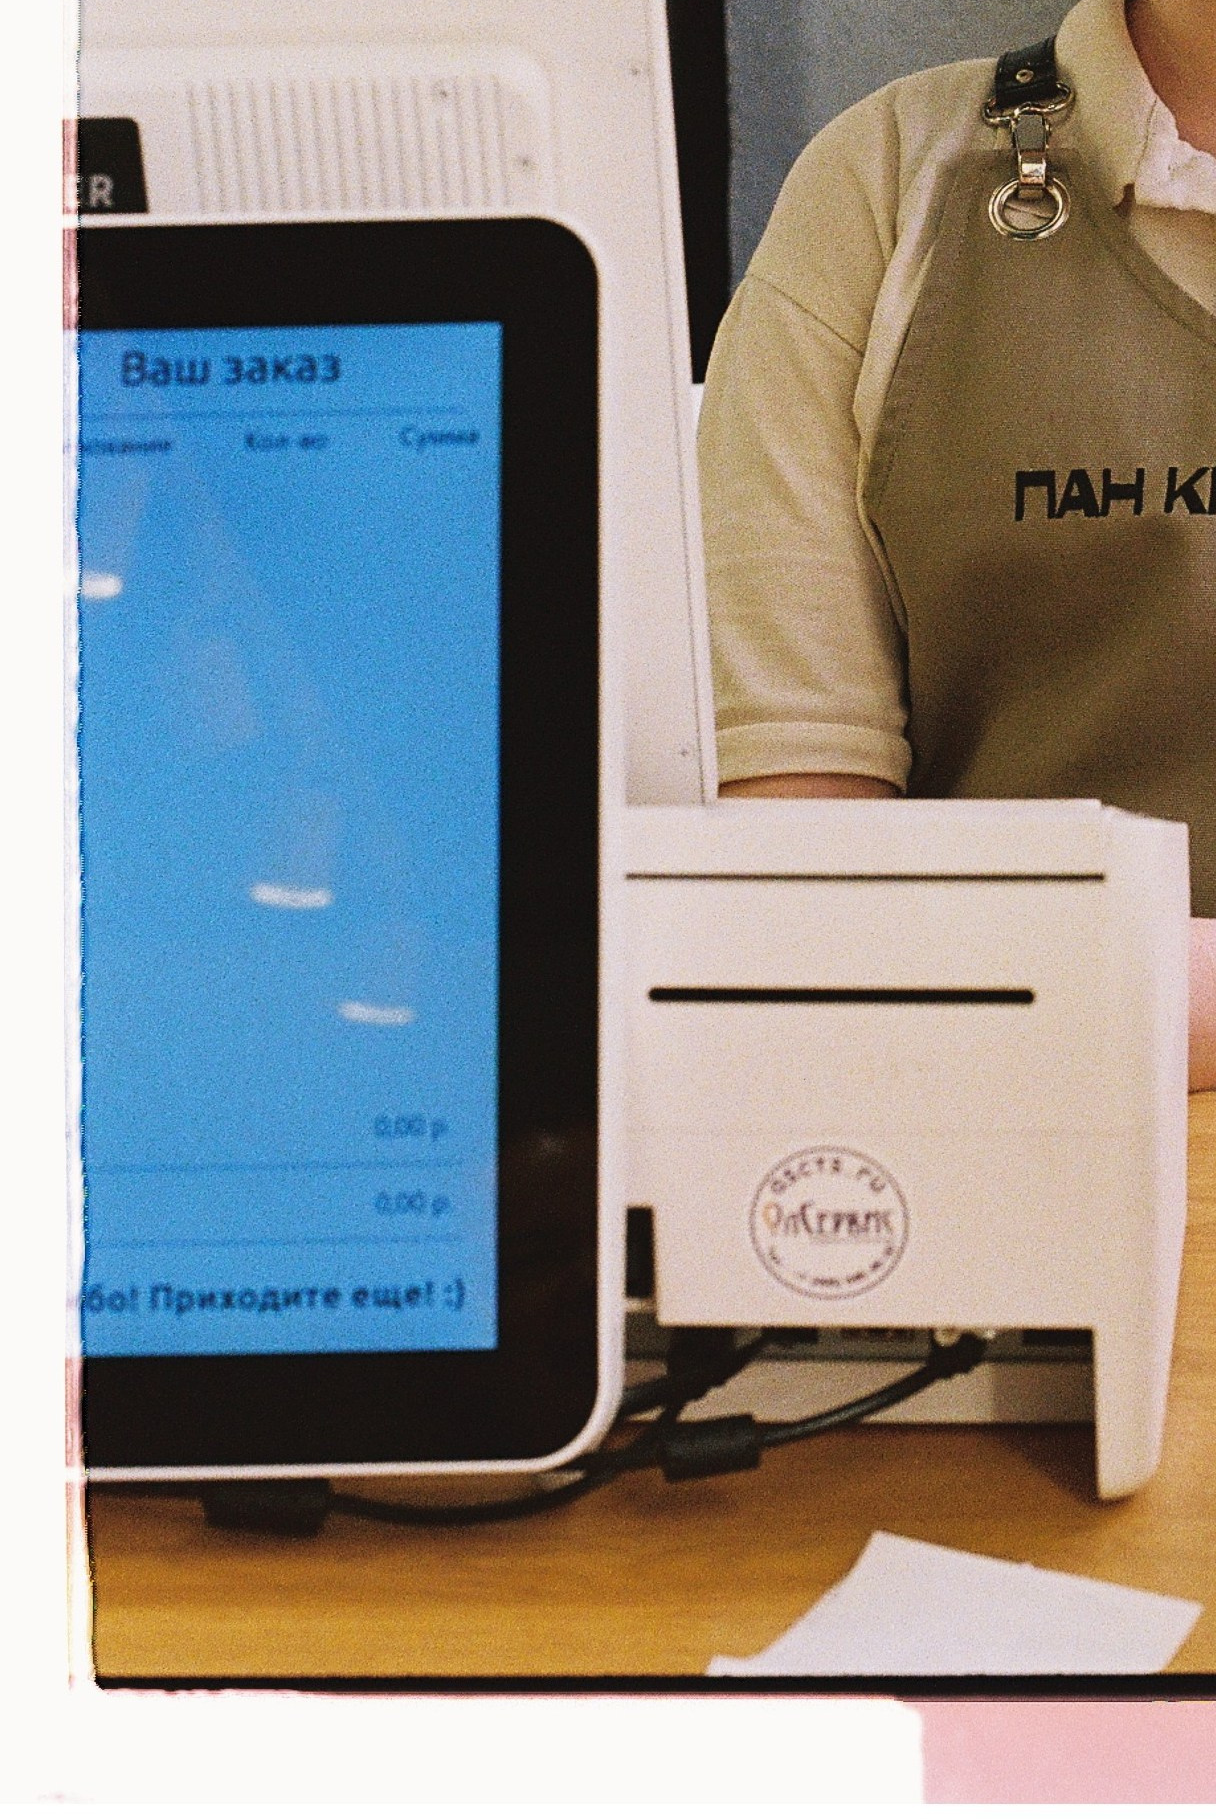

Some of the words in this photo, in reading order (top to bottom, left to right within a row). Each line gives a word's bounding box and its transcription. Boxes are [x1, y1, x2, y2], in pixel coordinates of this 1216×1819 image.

[120, 350, 211, 387] Ваш
[222, 352, 342, 383] заказ
[1014, 467, 1145, 522] ПАН
[151, 1282, 341, 1317] Приходите
[351, 1278, 435, 1310] еще!
